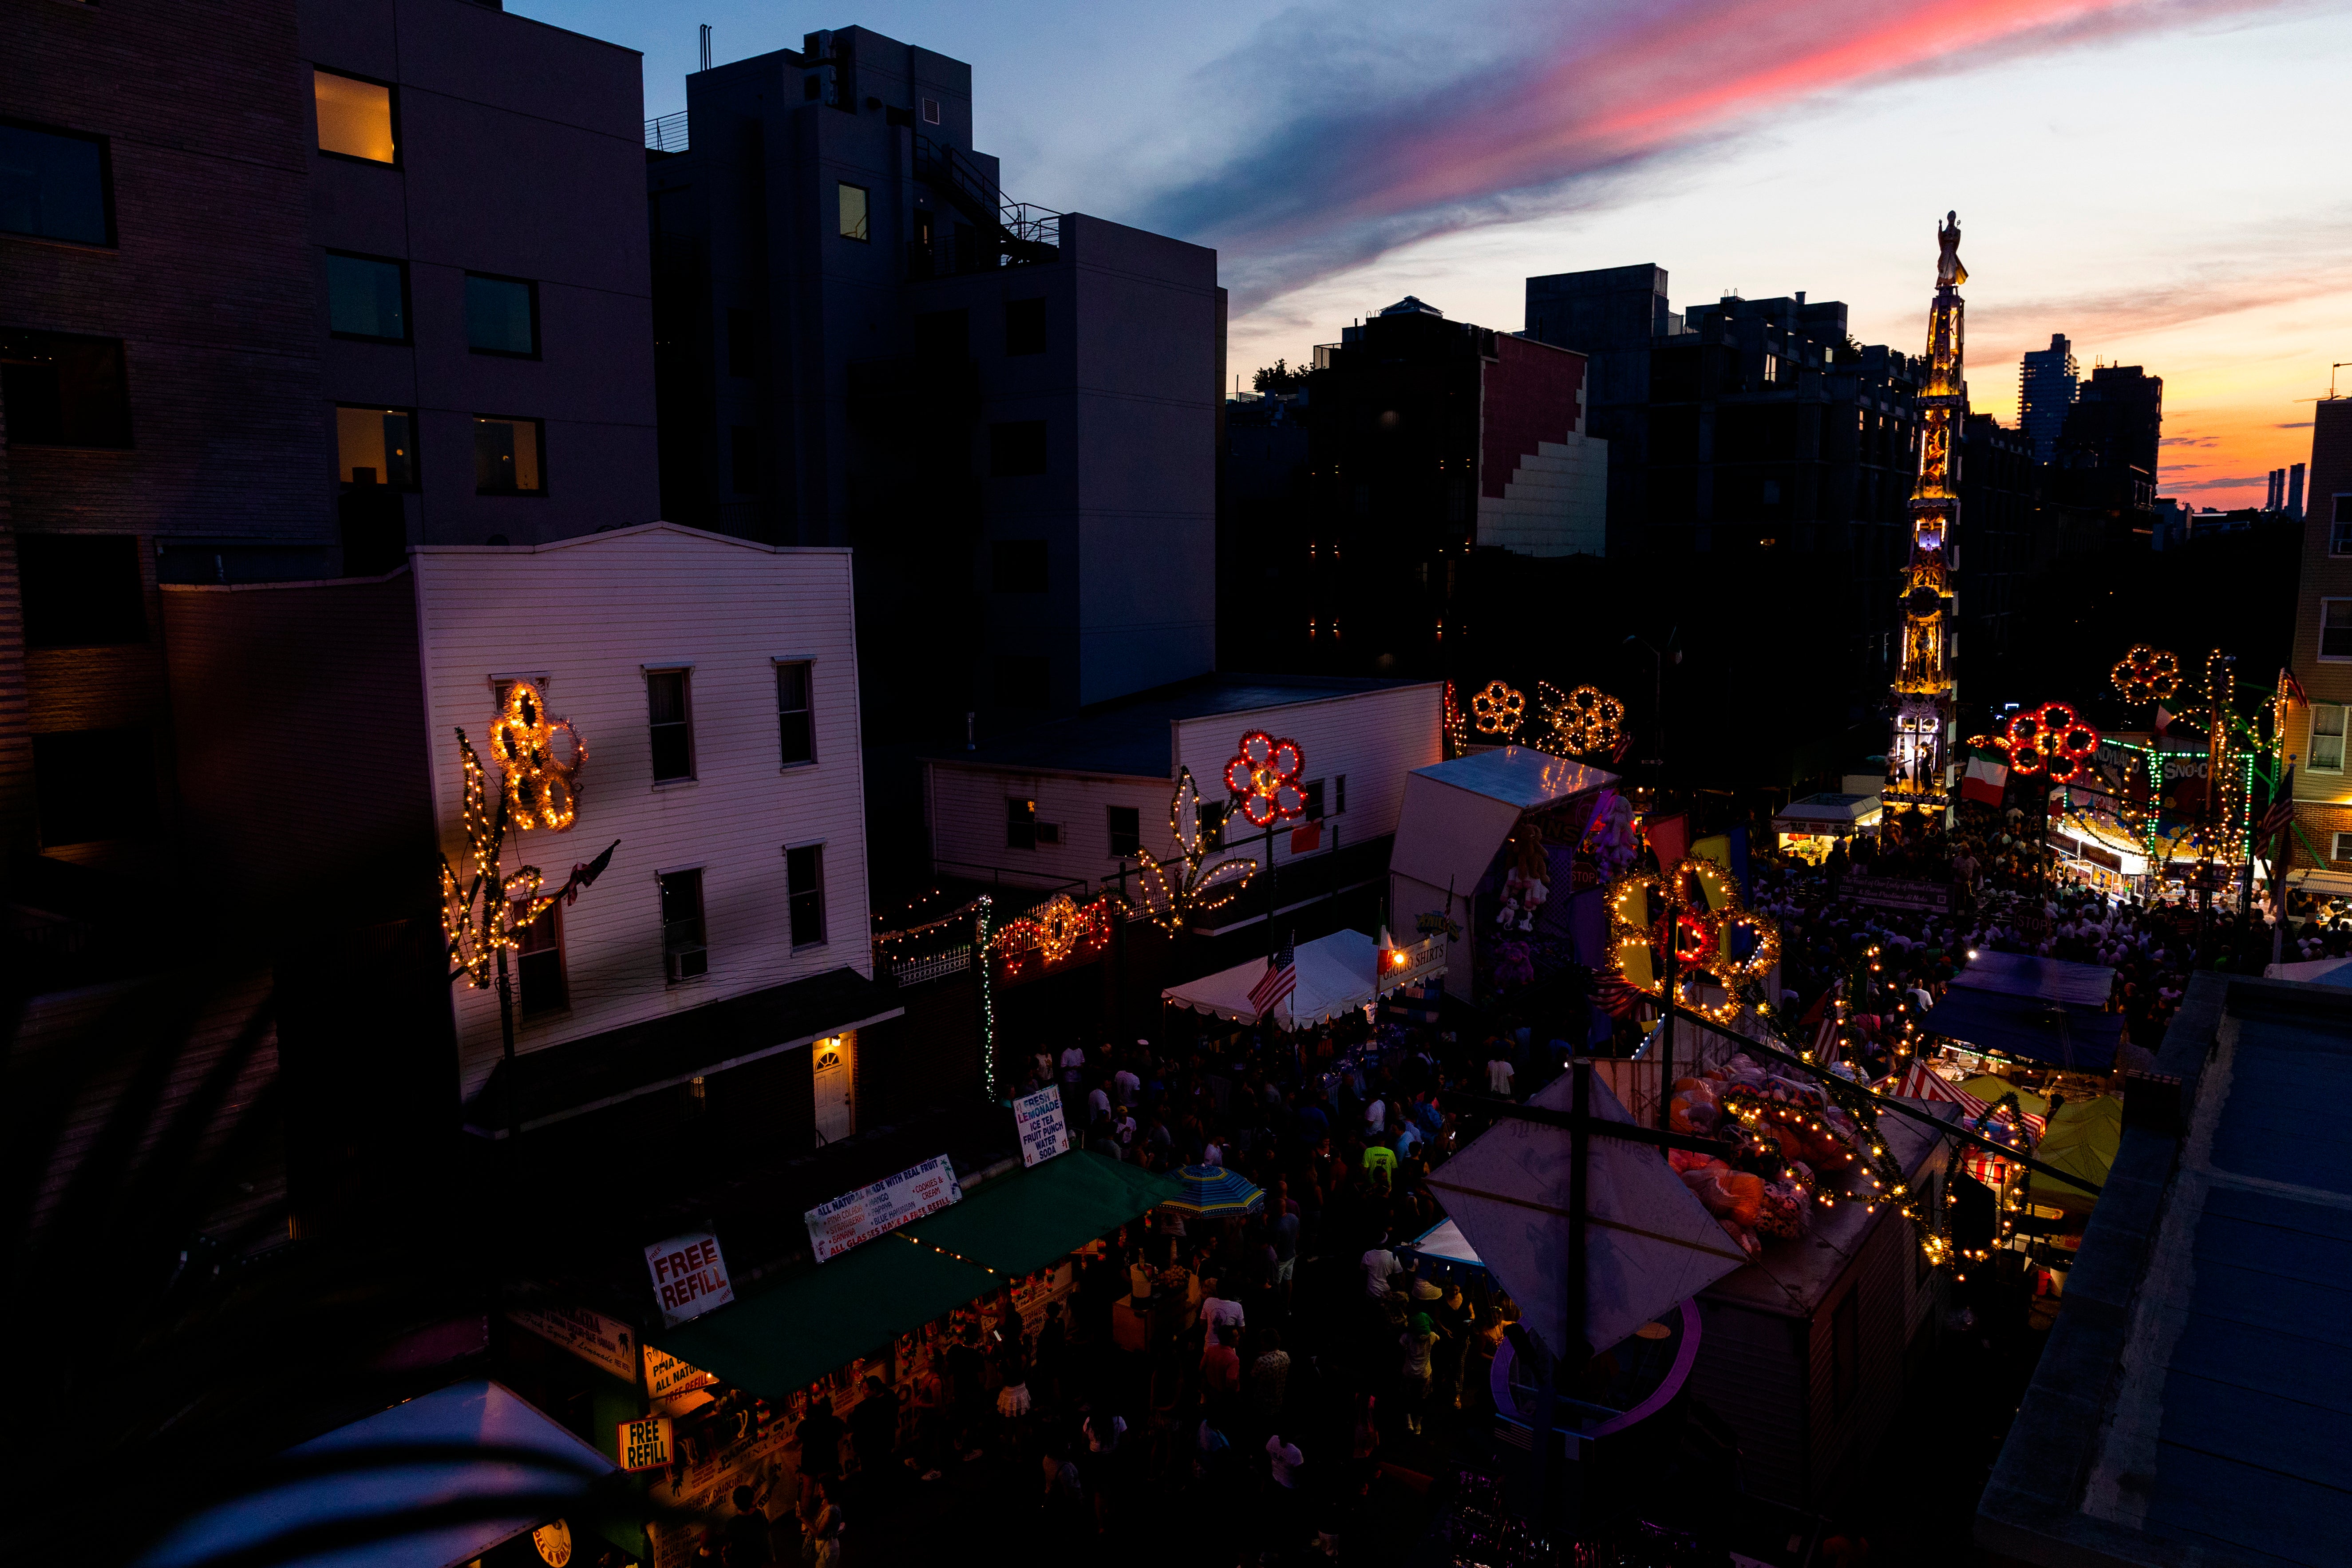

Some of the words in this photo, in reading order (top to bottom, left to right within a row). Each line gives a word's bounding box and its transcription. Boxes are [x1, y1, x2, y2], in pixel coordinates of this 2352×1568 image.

[2164, 762, 2247, 782] SNO-CS
[1878, 891, 1903, 900] Paolino
[1416, 913, 1460, 943] KNICS
[2017, 915, 2047, 931] STOP
[1383, 956, 1413, 980] GIGLIO
[1415, 944, 1443, 968] SHIRTS
[1024, 1092, 1050, 1108] FRESH
[1052, 1089, 1058, 1099] $1
[1016, 1102, 1022, 1113] $1
[1018, 1099, 1059, 1124] LEMONADE
[1030, 1120, 1041, 1131] ICE
[1042, 1115, 1054, 1126] TEA
[1023, 1130, 1041, 1145] FRUIT
[1043, 1121, 1063, 1137] PUNCH
[1035, 1134, 1056, 1150] WATER
[1039, 1145, 1056, 1159] SODA
[1062, 1138, 1067, 1148] $1
[1026, 1153, 1032, 1164] $1
[817, 1207, 832, 1216] ALL
[833, 1191, 865, 1212] NATURAL
[866, 1182, 885, 1197] MADE
[885, 1174, 903, 1188] WITH
[902, 1166, 920, 1180] REAL
[921, 1159, 938, 1174] FRUIT
[915, 1178, 937, 1193] COOKIES
[922, 1187, 941, 1201] CREAM
[869, 1193, 889, 1207] MANGO
[871, 1201, 893, 1216] PAPAYA
[827, 1213, 841, 1224] PINA
[842, 1204, 863, 1218] COLADA
[874, 1214, 889, 1225] BLUE
[889, 1201, 916, 1220] HAWAIIAN
[830, 1213, 866, 1234] STRAWBERRY
[830, 1245, 845, 1256] ALL
[846, 1228, 880, 1248] GLASSES
[882, 1217, 901, 1232] HAVE
[903, 1215, 909, 1223] A
[910, 1207, 925, 1220] FREE
[927, 1197, 951, 1213] REFILL
[832, 1228, 856, 1243] BANANA
[649, 1246, 662, 1261] FREE
[654, 1238, 718, 1284] FREE
[660, 1266, 727, 1311] REFILL
[719, 1288, 731, 1303] FREE
[577, 1341, 613, 1363] Lemonade
[656, 1377, 671, 1393] ALL
[665, 1386, 683, 1406] FREE
[685, 1373, 708, 1395] REFILL
[630, 1420, 659, 1446] FREE
[628, 1441, 667, 1468] REFILL
[713, 1473, 743, 1499] DAIQUIRI
[699, 1494, 727, 1517] AIQUIRI
[661, 1541, 680, 1560] BLUE
[662, 1549, 690, 1568] PAPAYA
